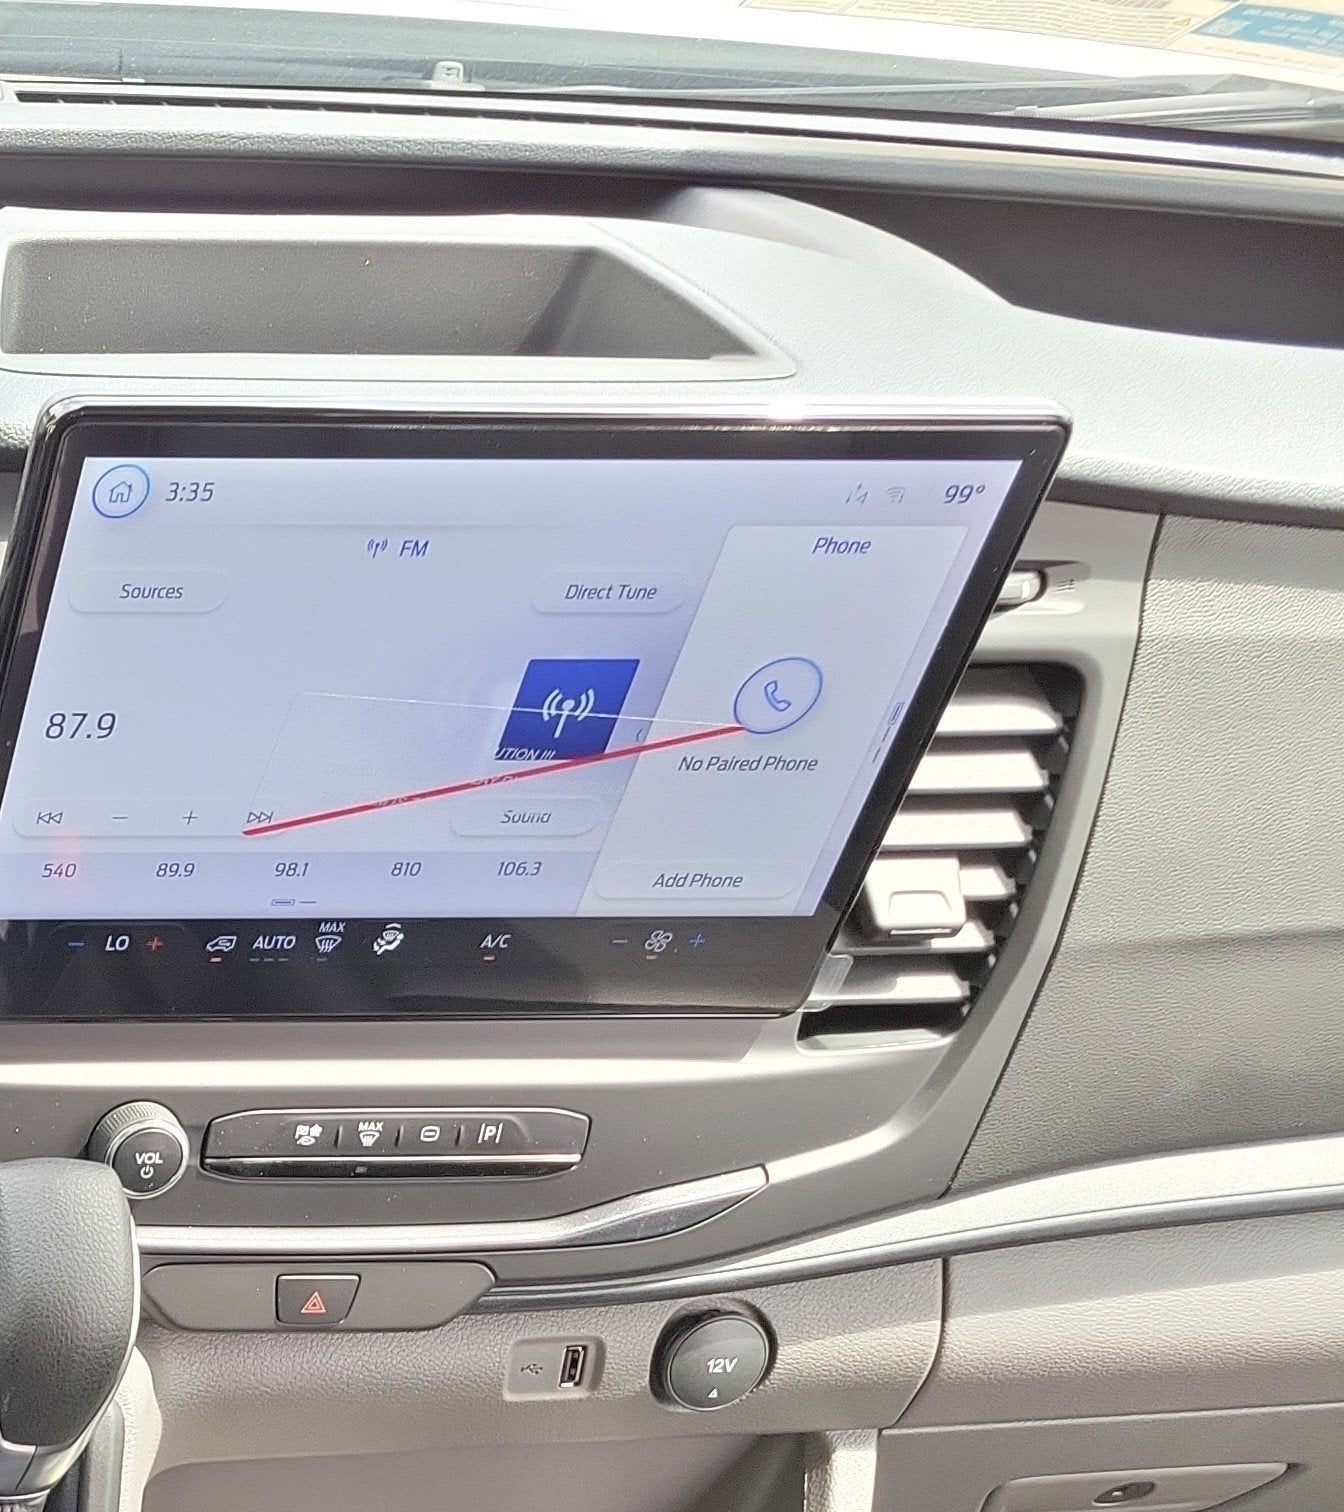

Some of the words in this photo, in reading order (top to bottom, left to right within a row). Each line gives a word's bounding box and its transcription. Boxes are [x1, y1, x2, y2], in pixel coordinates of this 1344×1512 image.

[165, 481, 215, 502] 3:35
[399, 539, 430, 558] FM
[812, 537, 872, 555] Phone
[118, 583, 184, 600] Sources
[565, 583, 613, 600] Direct
[617, 584, 658, 600] Tune
[45, 712, 117, 740] 87.9
[678, 756, 703, 772] No
[705, 756, 763, 772] Paired
[762, 756, 819, 772] Phone
[41, 862, 77, 878] 540
[155, 862, 196, 878] 89.9
[274, 862, 310, 877] 98.1
[390, 861, 422, 877] 810
[497, 861, 542, 877] 106.3
[652, 873, 688, 888] Add
[688, 873, 743, 888] Phone
[319, 921, 347, 933] MAX
[105, 935, 131, 951] LO
[252, 935, 297, 950] AUTO
[480, 934, 512, 949] A/C
[357, 1121, 384, 1132] MAX
[134, 1151, 164, 1165] VOL
[706, 1357, 739, 1374] 12V
